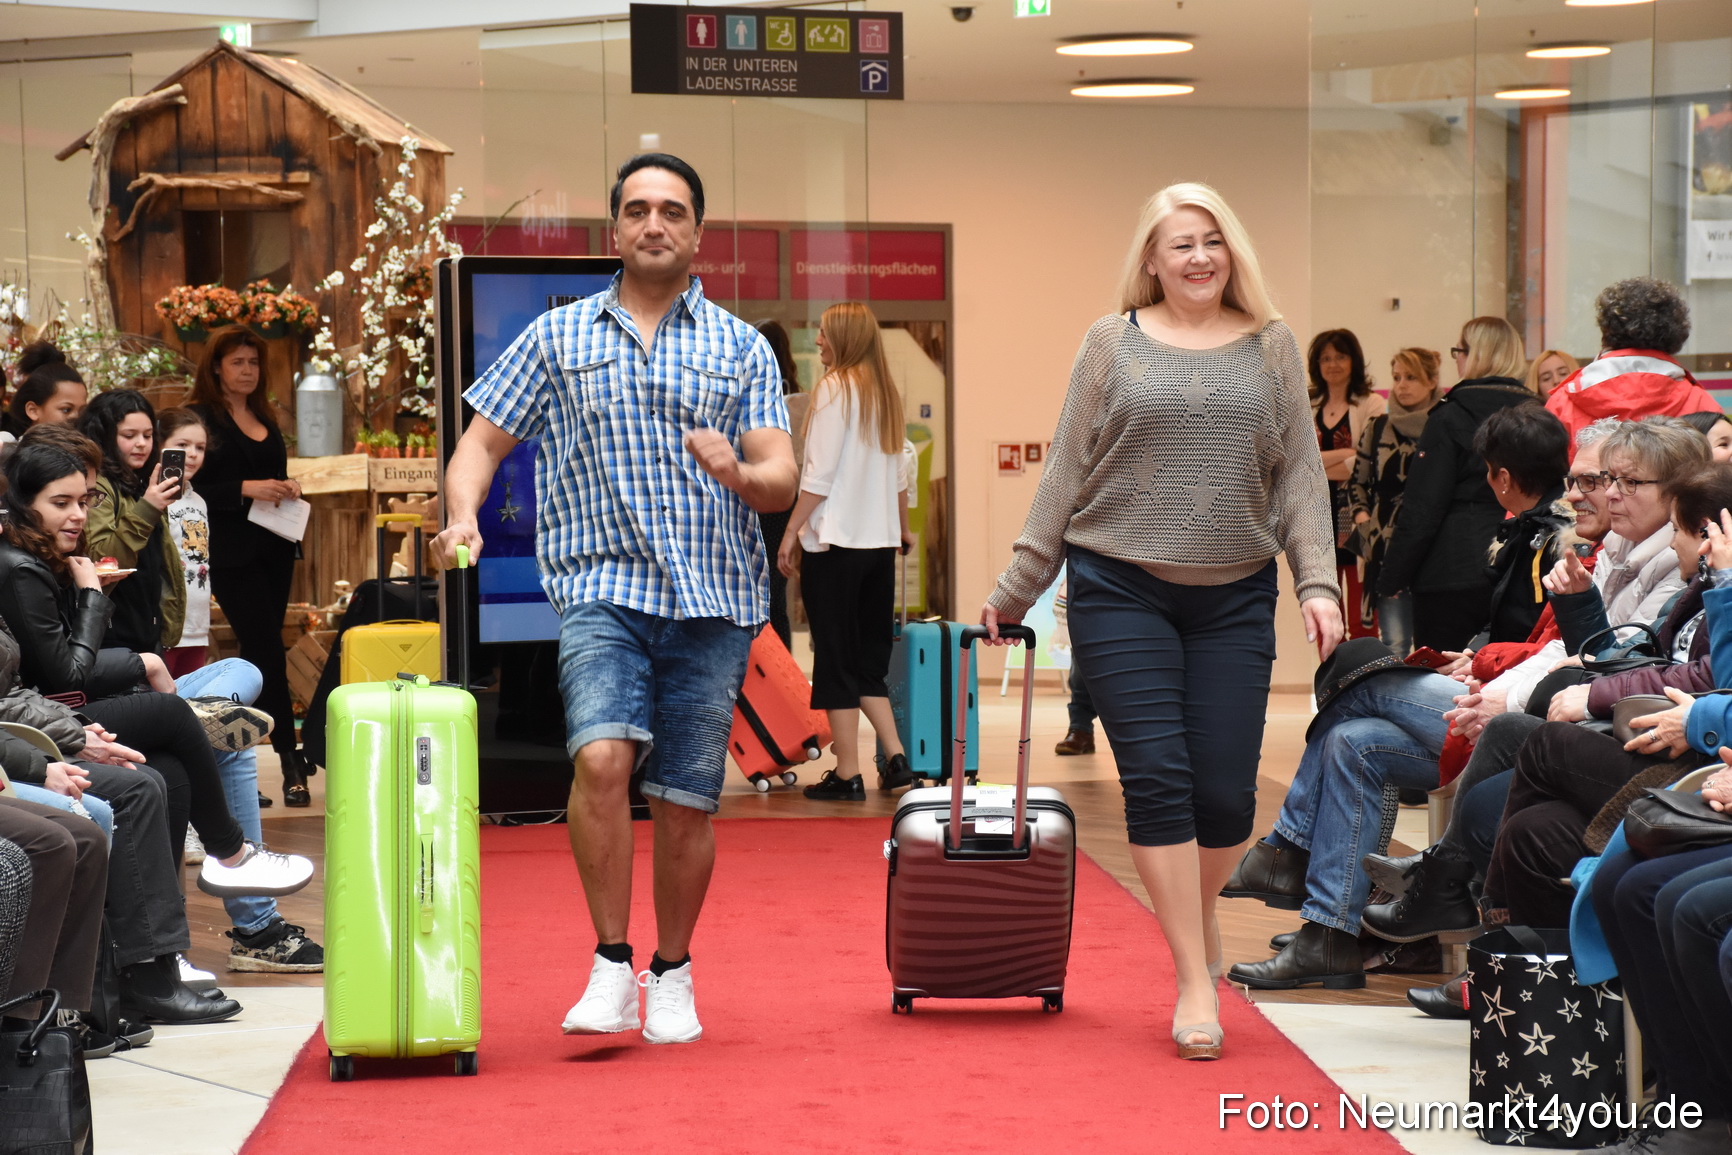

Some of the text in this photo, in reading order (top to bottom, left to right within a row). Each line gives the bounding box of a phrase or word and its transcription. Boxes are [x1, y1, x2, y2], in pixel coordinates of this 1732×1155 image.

[769, 22, 780, 30] WC
[685, 57, 798, 73] IN DER UNTEREN
[686, 76, 798, 93] LADENSTRASSE
[868, 70, 882, 91] P
[721, 260, 746, 275] und
[796, 261, 937, 278] Dienstleistungsflächen
